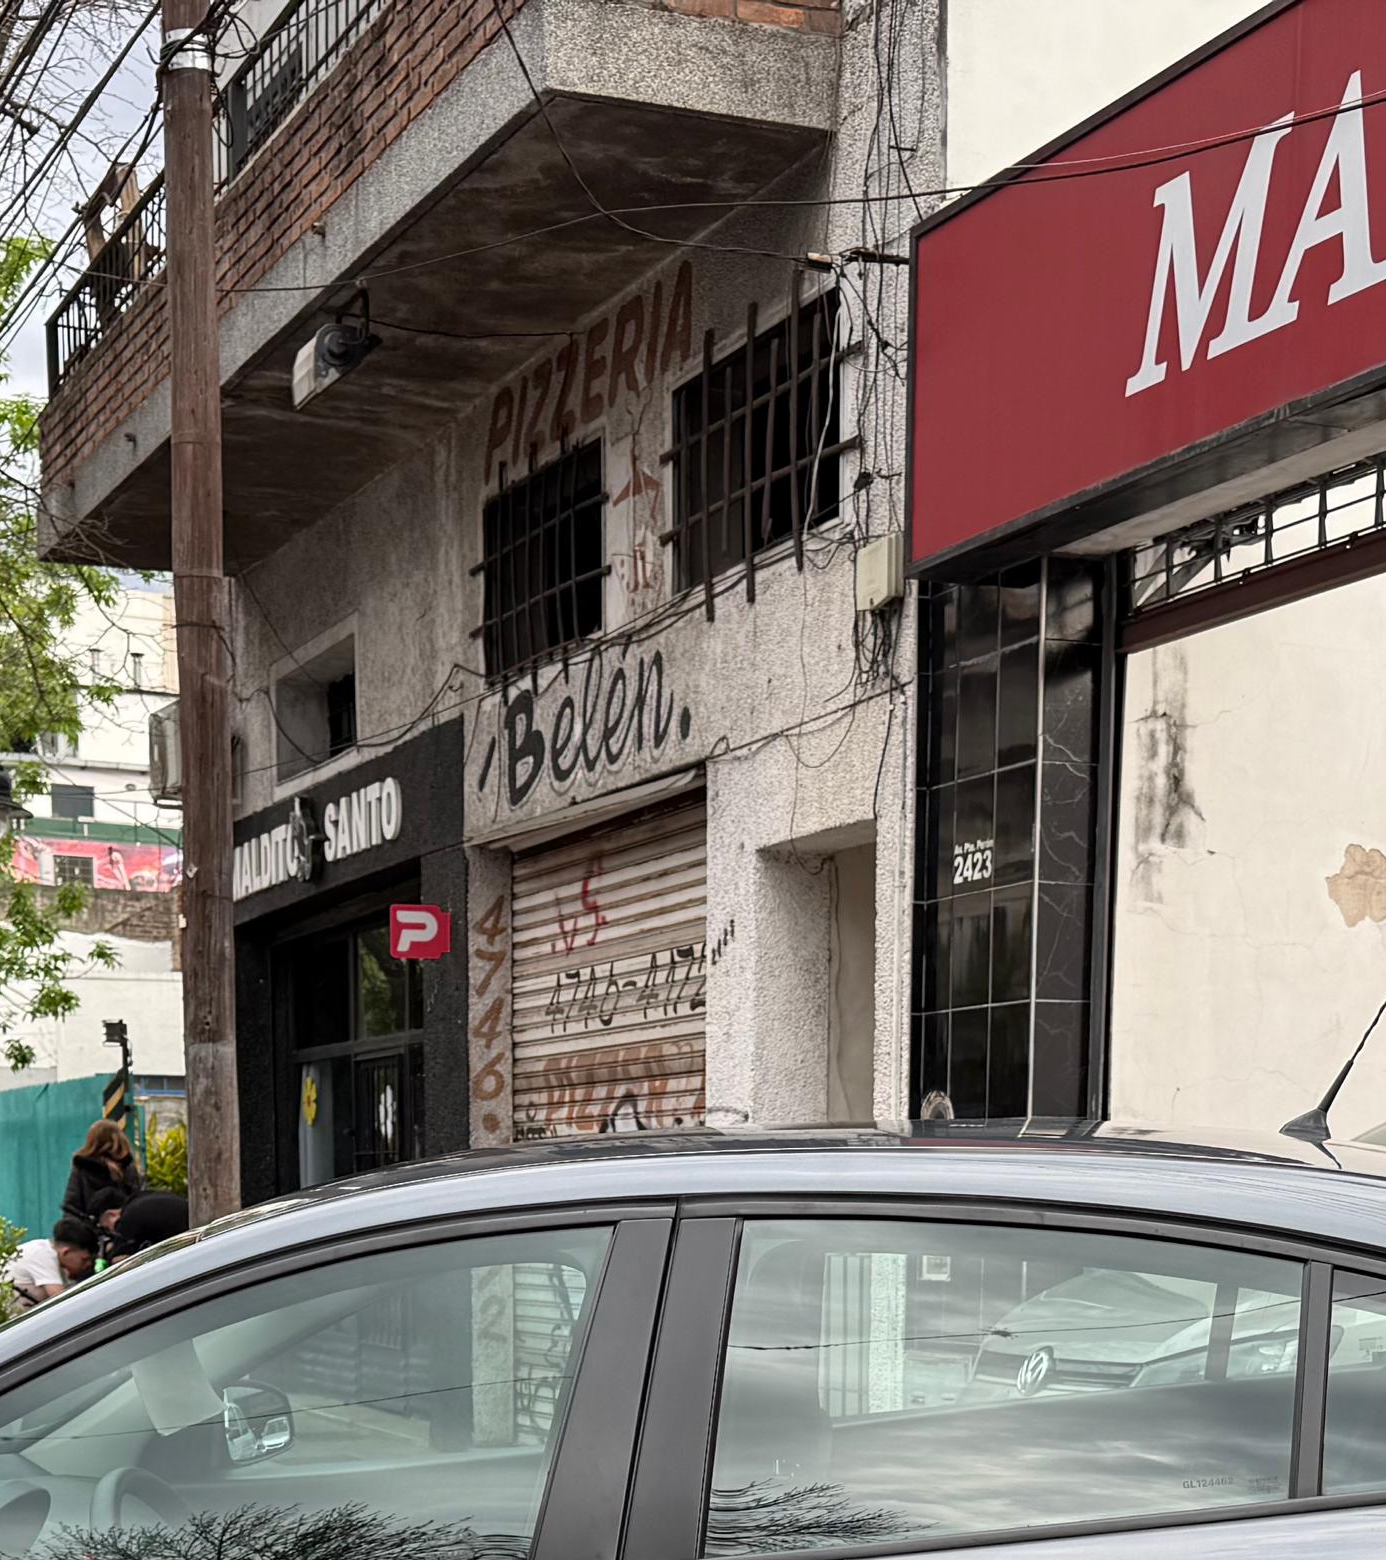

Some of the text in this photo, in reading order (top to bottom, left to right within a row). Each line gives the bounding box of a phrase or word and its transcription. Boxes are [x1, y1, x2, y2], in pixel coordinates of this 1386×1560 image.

[484, 260, 693, 486] PIZZERIA
[324, 777, 403, 863] SANTO
[953, 849, 992, 885] 2423
